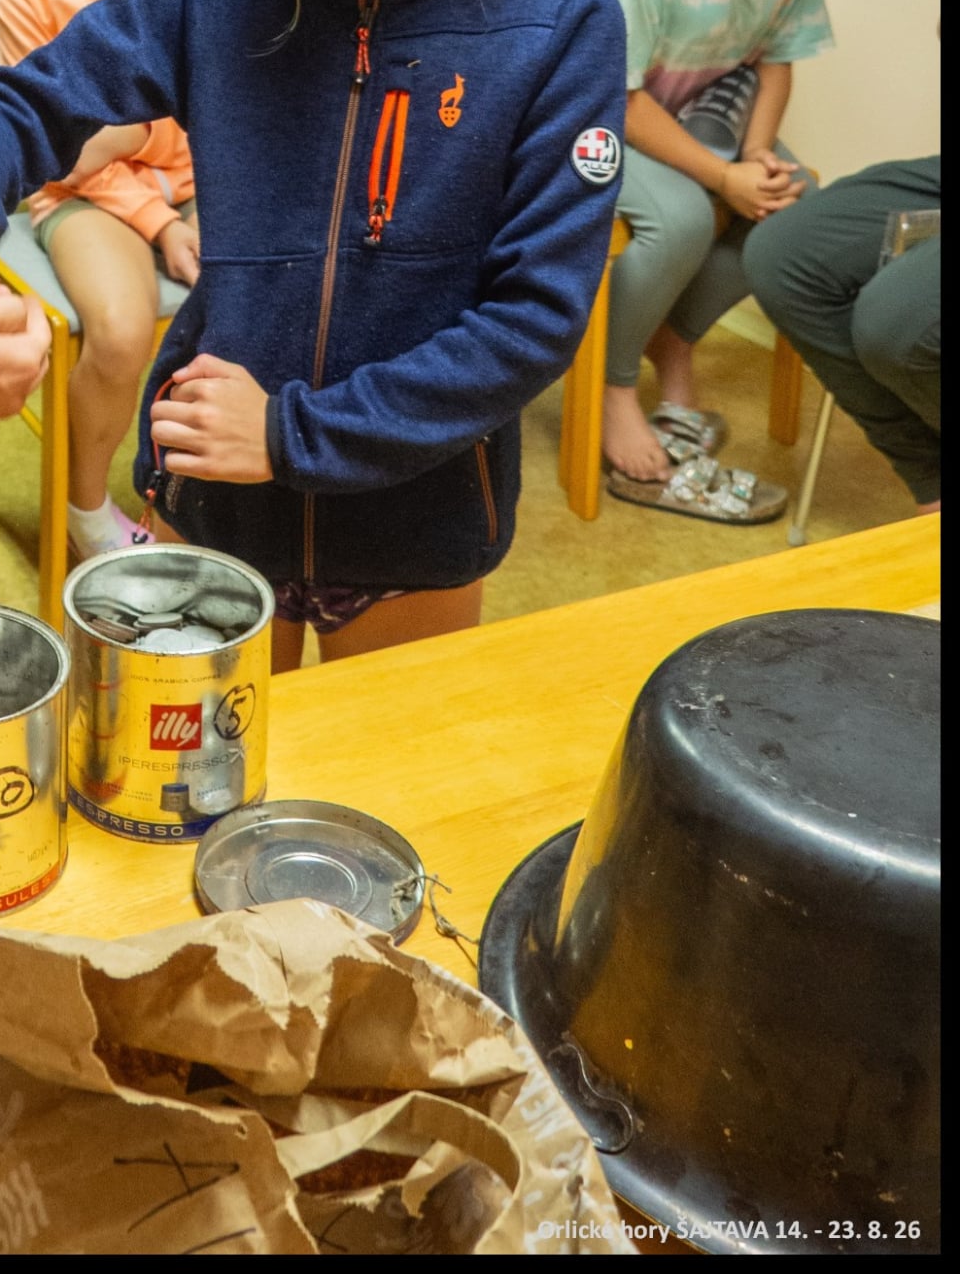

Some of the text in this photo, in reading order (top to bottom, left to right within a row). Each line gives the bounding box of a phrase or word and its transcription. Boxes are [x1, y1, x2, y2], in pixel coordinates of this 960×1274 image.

[152, 711, 200, 748] illy
[225, 695, 247, 737] 5
[117, 753, 230, 773] IPERESPRESSO
